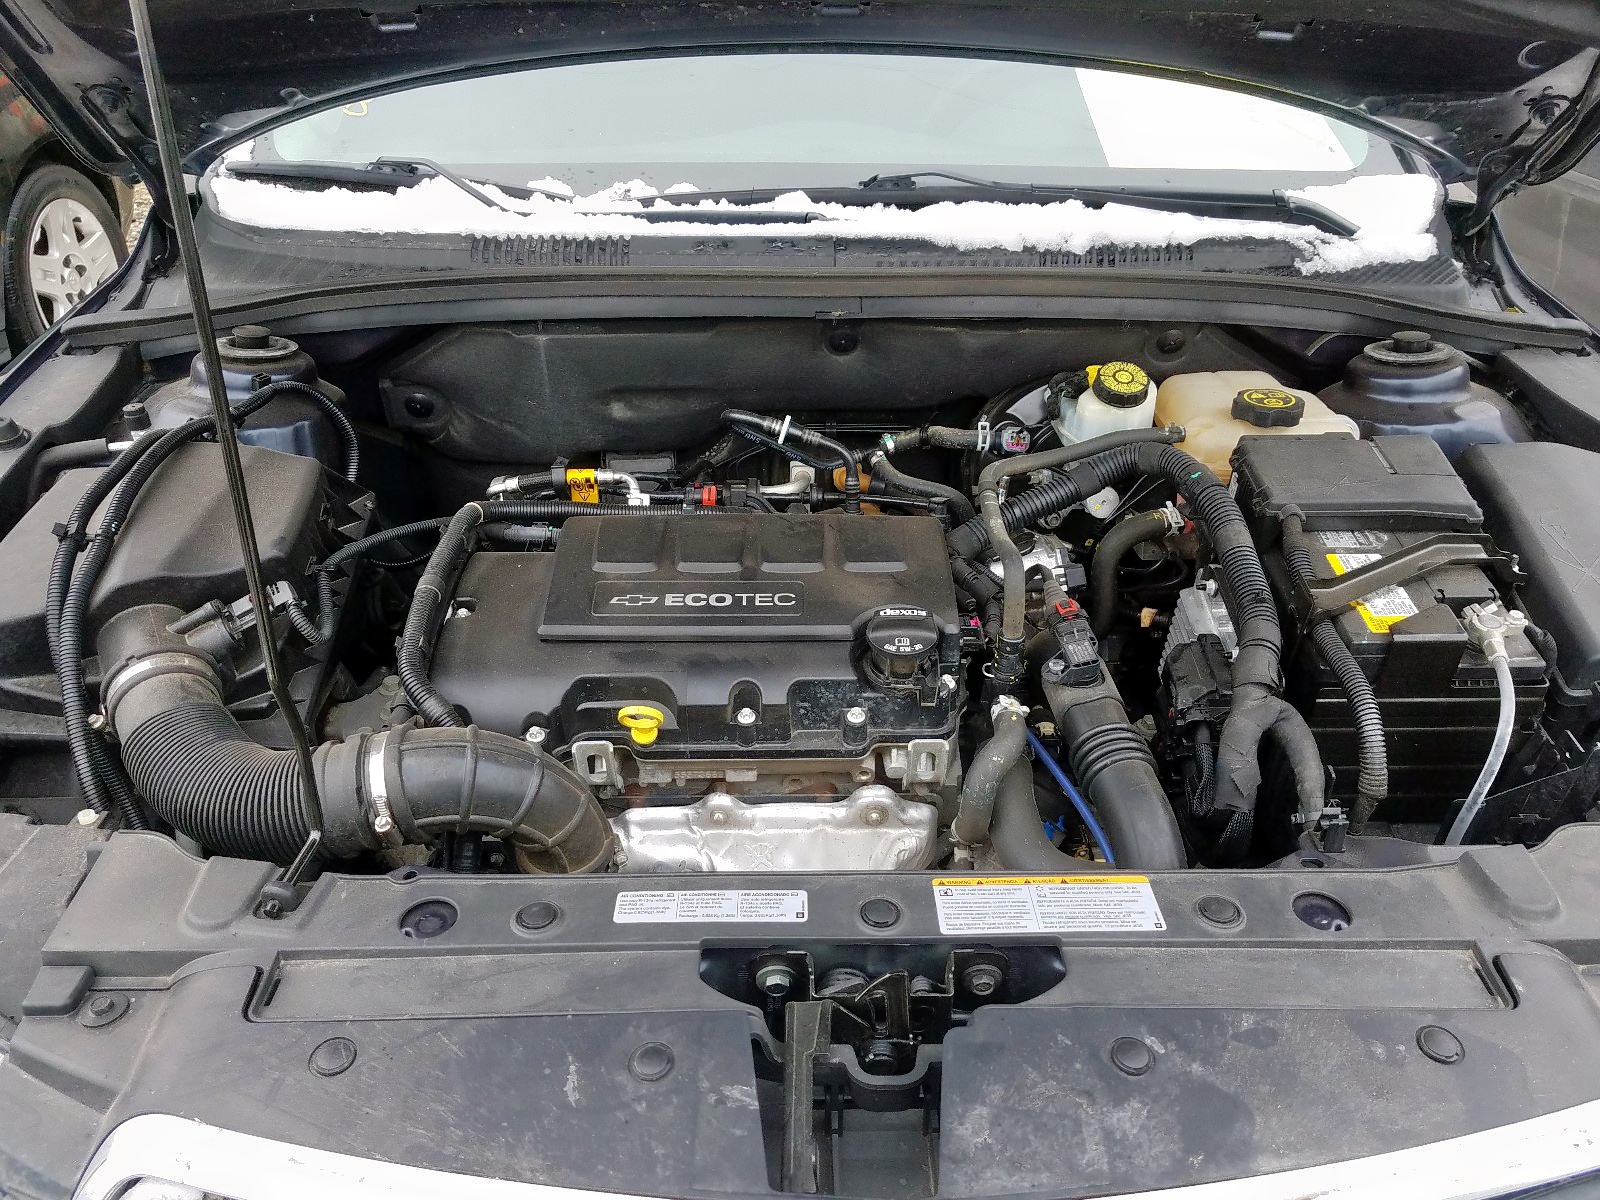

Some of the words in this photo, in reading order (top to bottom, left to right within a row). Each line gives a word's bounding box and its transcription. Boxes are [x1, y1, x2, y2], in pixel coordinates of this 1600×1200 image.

[664, 593, 797, 607] ECOTEC
[879, 608, 929, 617] dexos
[883, 643, 898, 652] SAE
[899, 643, 924, 653] 5W-30
